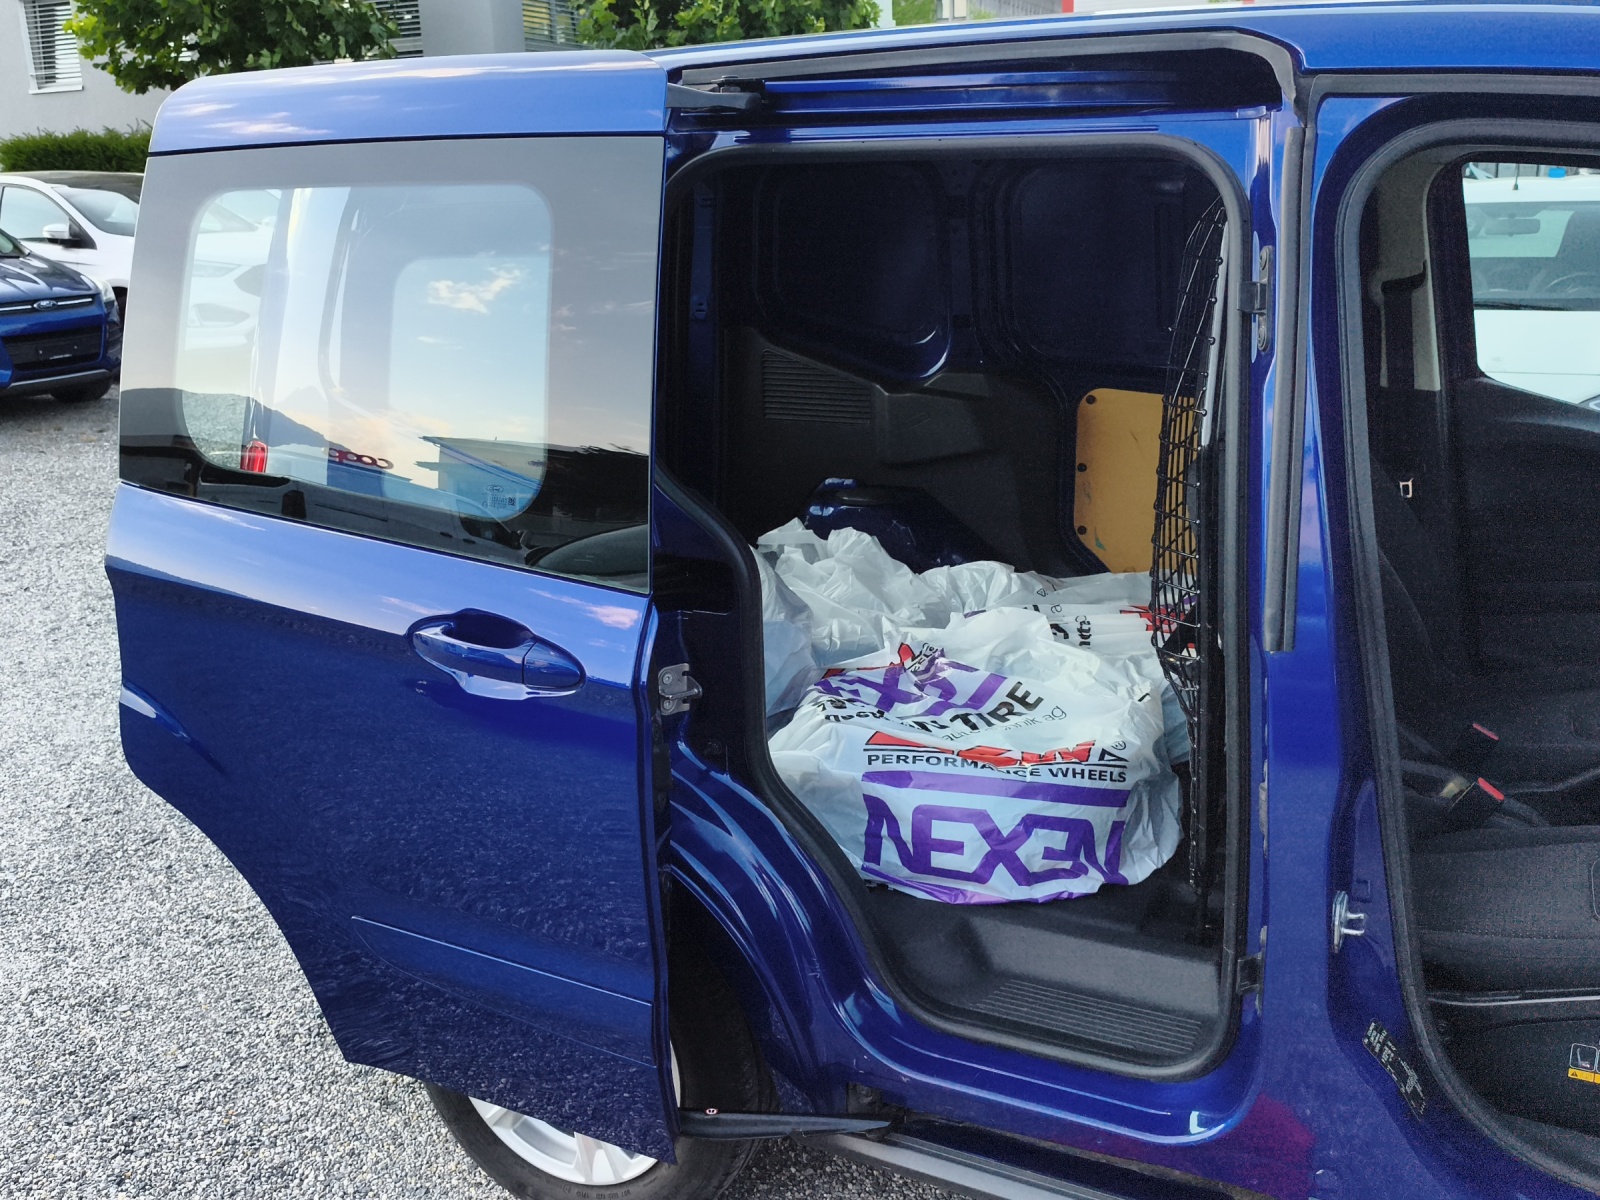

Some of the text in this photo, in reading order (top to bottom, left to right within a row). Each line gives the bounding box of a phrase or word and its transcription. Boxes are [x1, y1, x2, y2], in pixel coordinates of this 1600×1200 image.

[949, 681, 1045, 731] TIRE
[1042, 705, 1067, 721] ag
[866, 754, 1127, 783] PERFORMANCE WHEELS
[862, 793, 1129, 886] NEXEN
